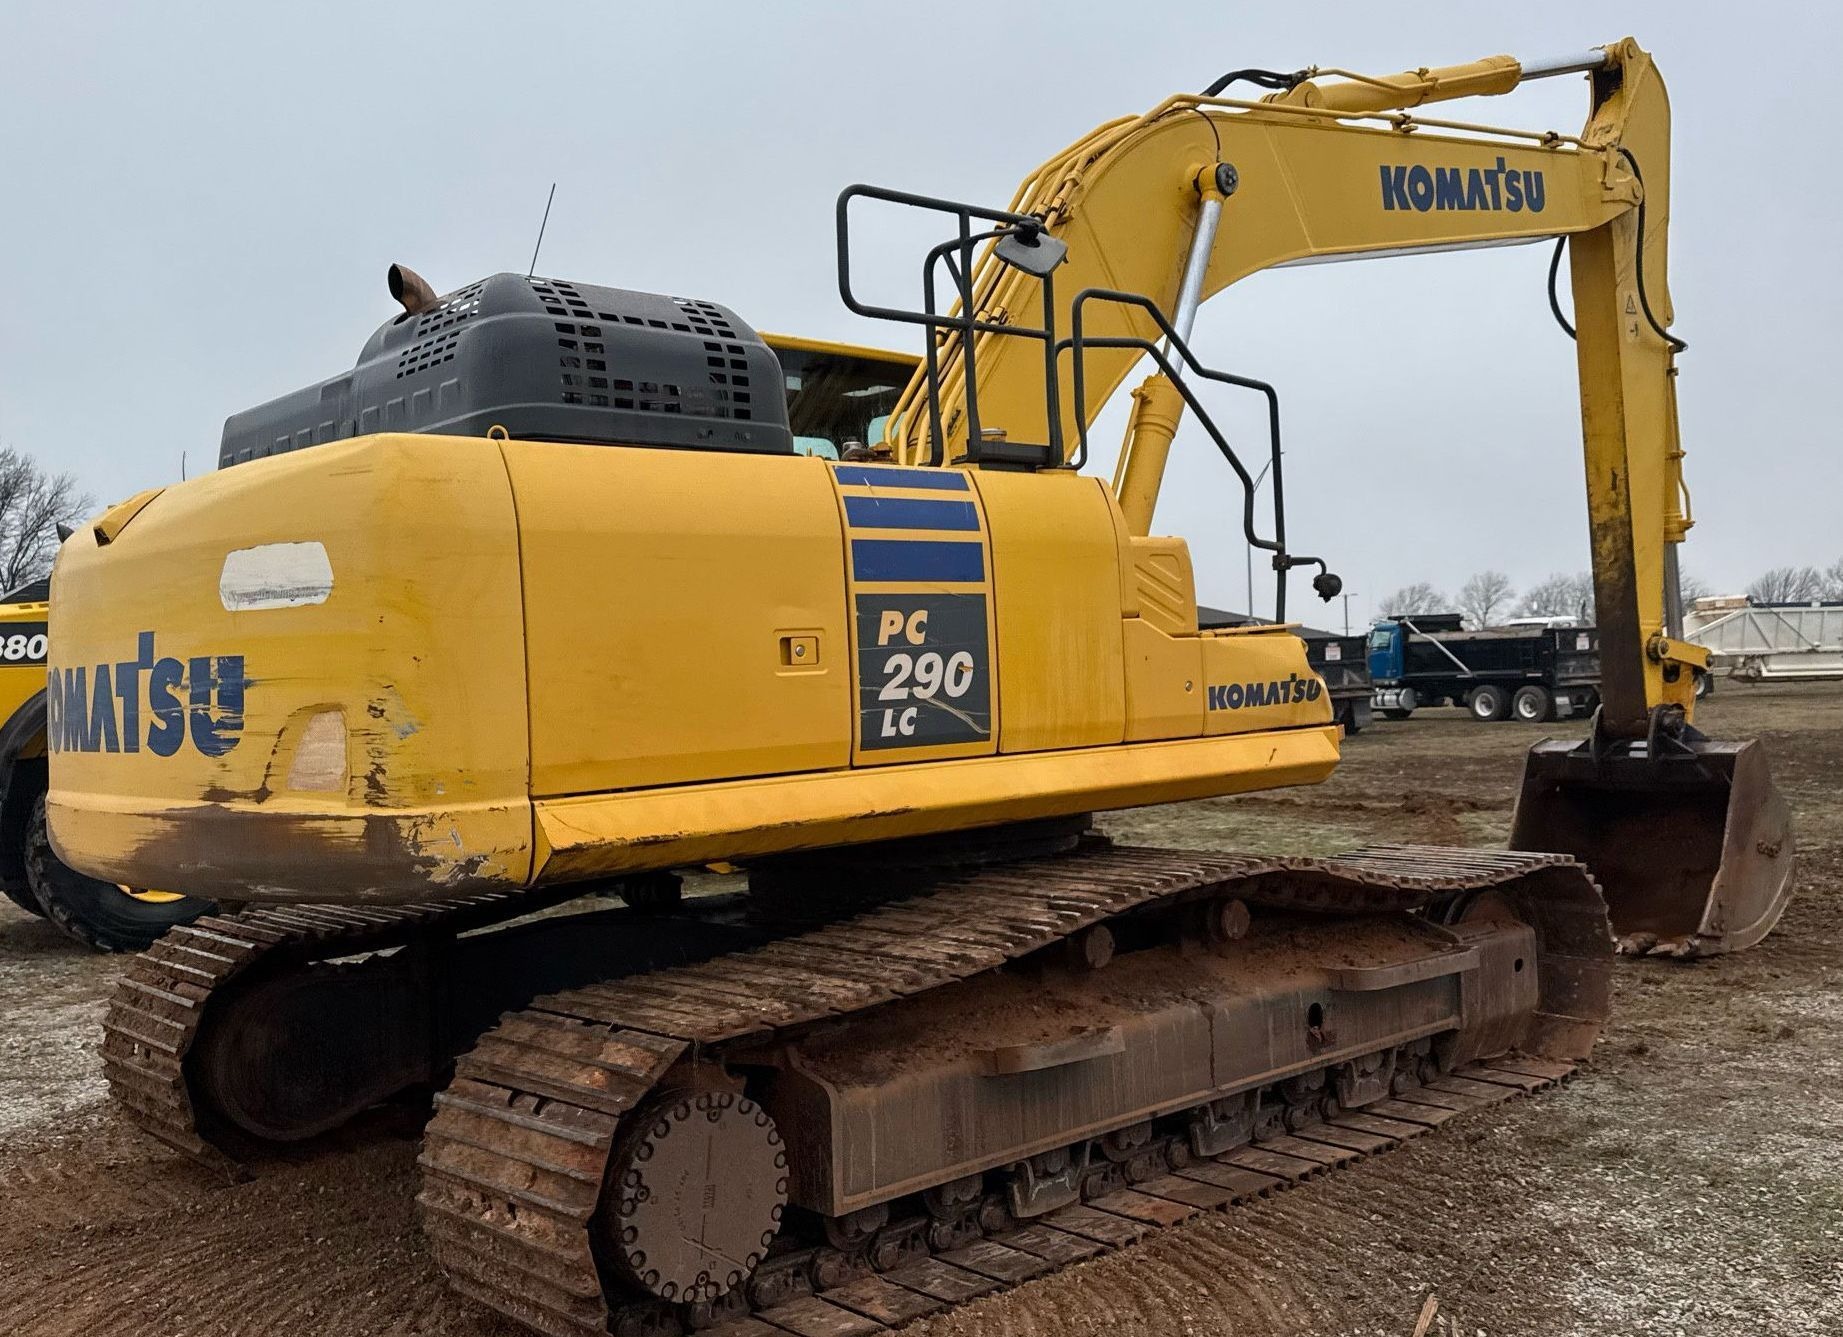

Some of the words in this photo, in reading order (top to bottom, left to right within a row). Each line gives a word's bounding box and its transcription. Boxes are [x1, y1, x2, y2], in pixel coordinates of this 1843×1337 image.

[1380, 156, 1545, 212] KOMATSU
[0, 633, 48, 661] 80
[878, 610, 928, 645] PC
[48, 632, 245, 757] OMATSU
[878, 651, 973, 700] 290
[1209, 672, 1322, 711] KOMATSU
[881, 707, 917, 737] LC
